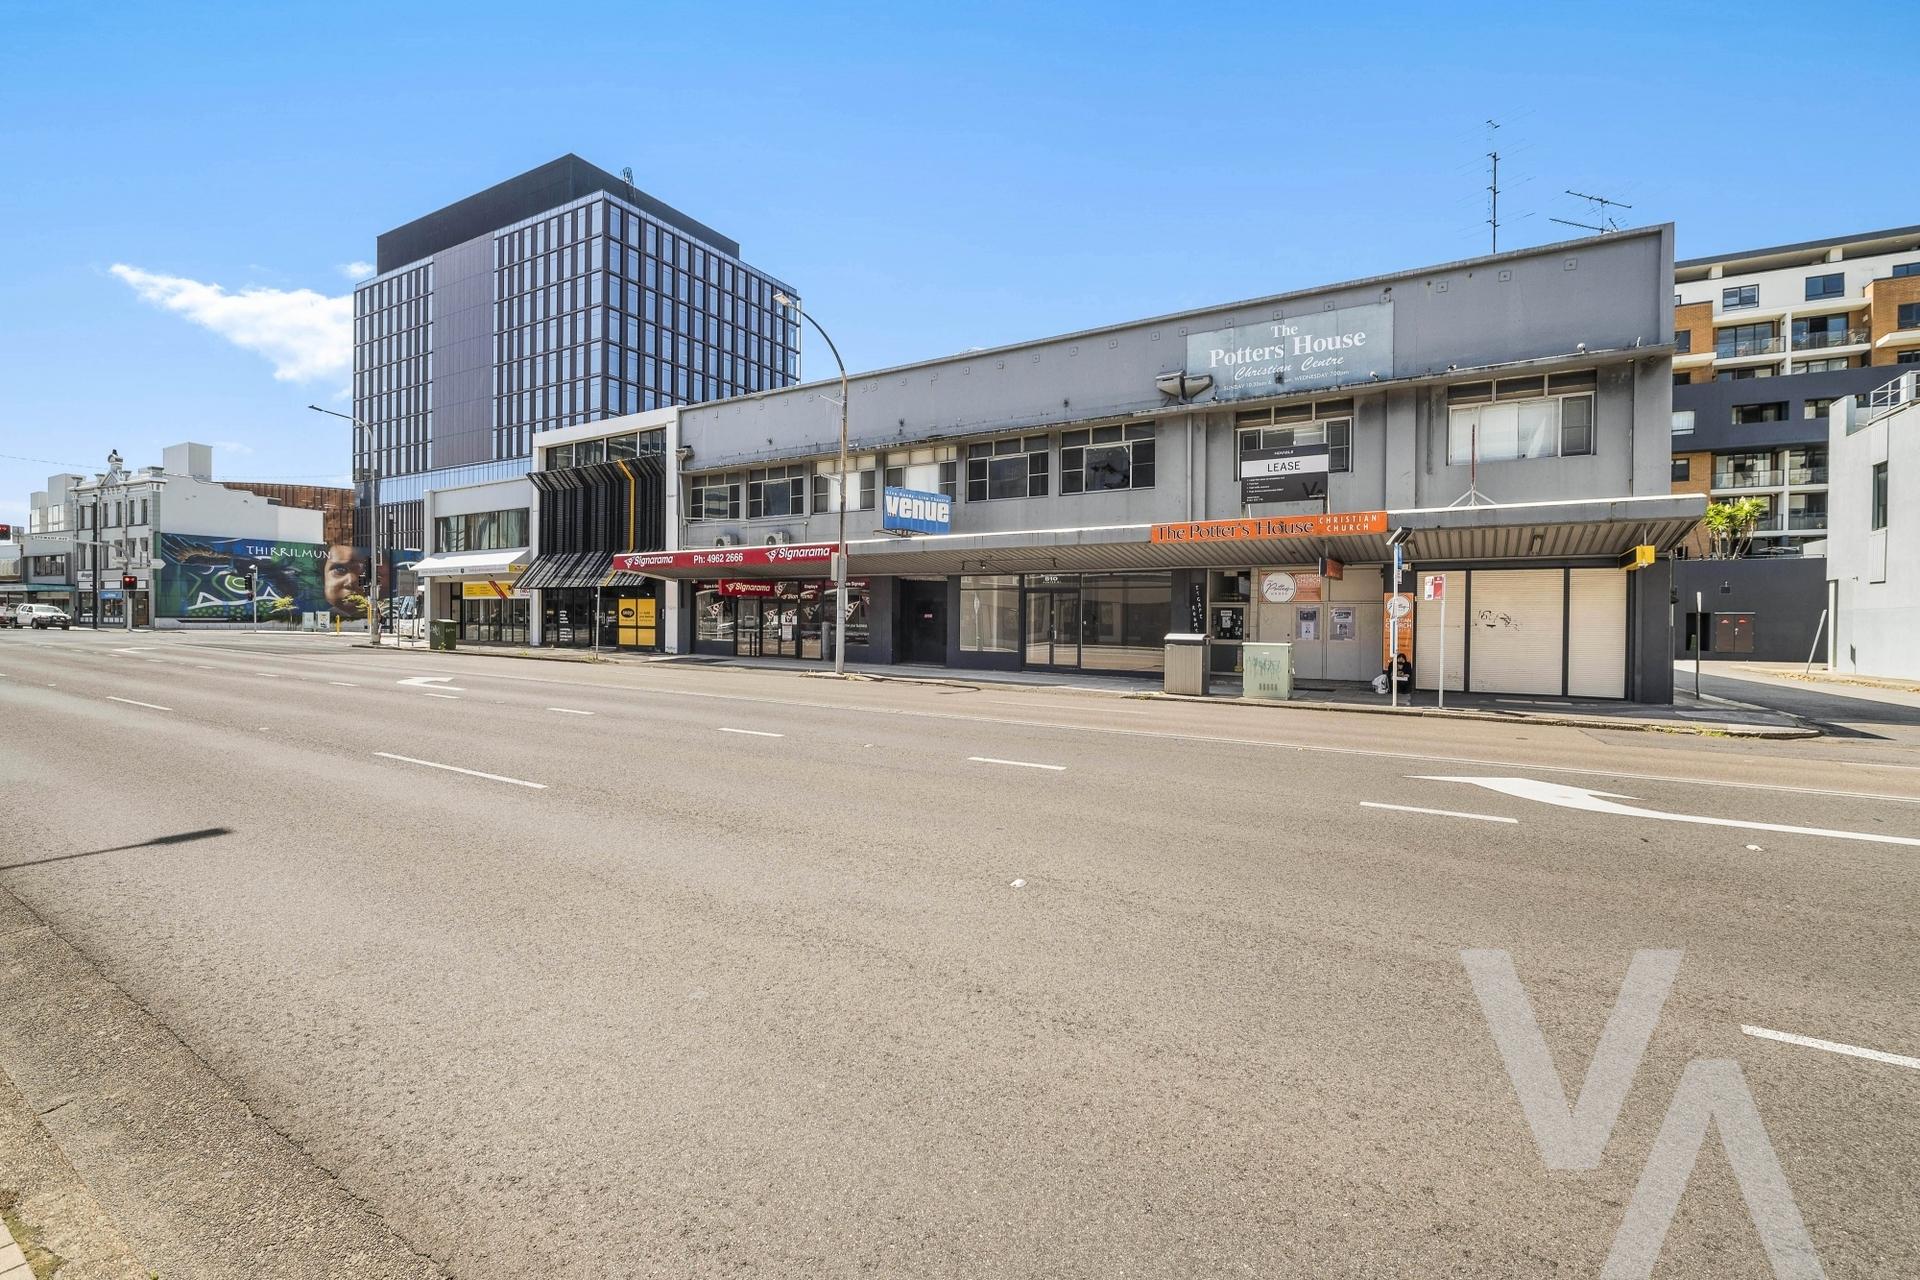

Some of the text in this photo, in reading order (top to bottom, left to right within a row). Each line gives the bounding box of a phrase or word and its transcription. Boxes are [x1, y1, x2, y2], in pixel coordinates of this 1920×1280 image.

[1270, 325, 1298, 338] The
[1209, 331, 1366, 369] Potters House
[1234, 355, 1345, 381] Christian Centre
[1223, 383, 1246, 391] SUNDAY
[1267, 461, 1301, 473] LEASE
[886, 495, 949, 523] venue
[1319, 514, 1377, 525] CHRISTIAN
[1157, 519, 1314, 541] The Potter's House
[1326, 523, 1369, 532] CHURCH
[246, 545, 331, 559] THIRRILMUN
[779, 547, 830, 560] Signarama
[634, 553, 744, 567] Signarama Ph: 4962 2666
[736, 582, 771, 594] Signarama
